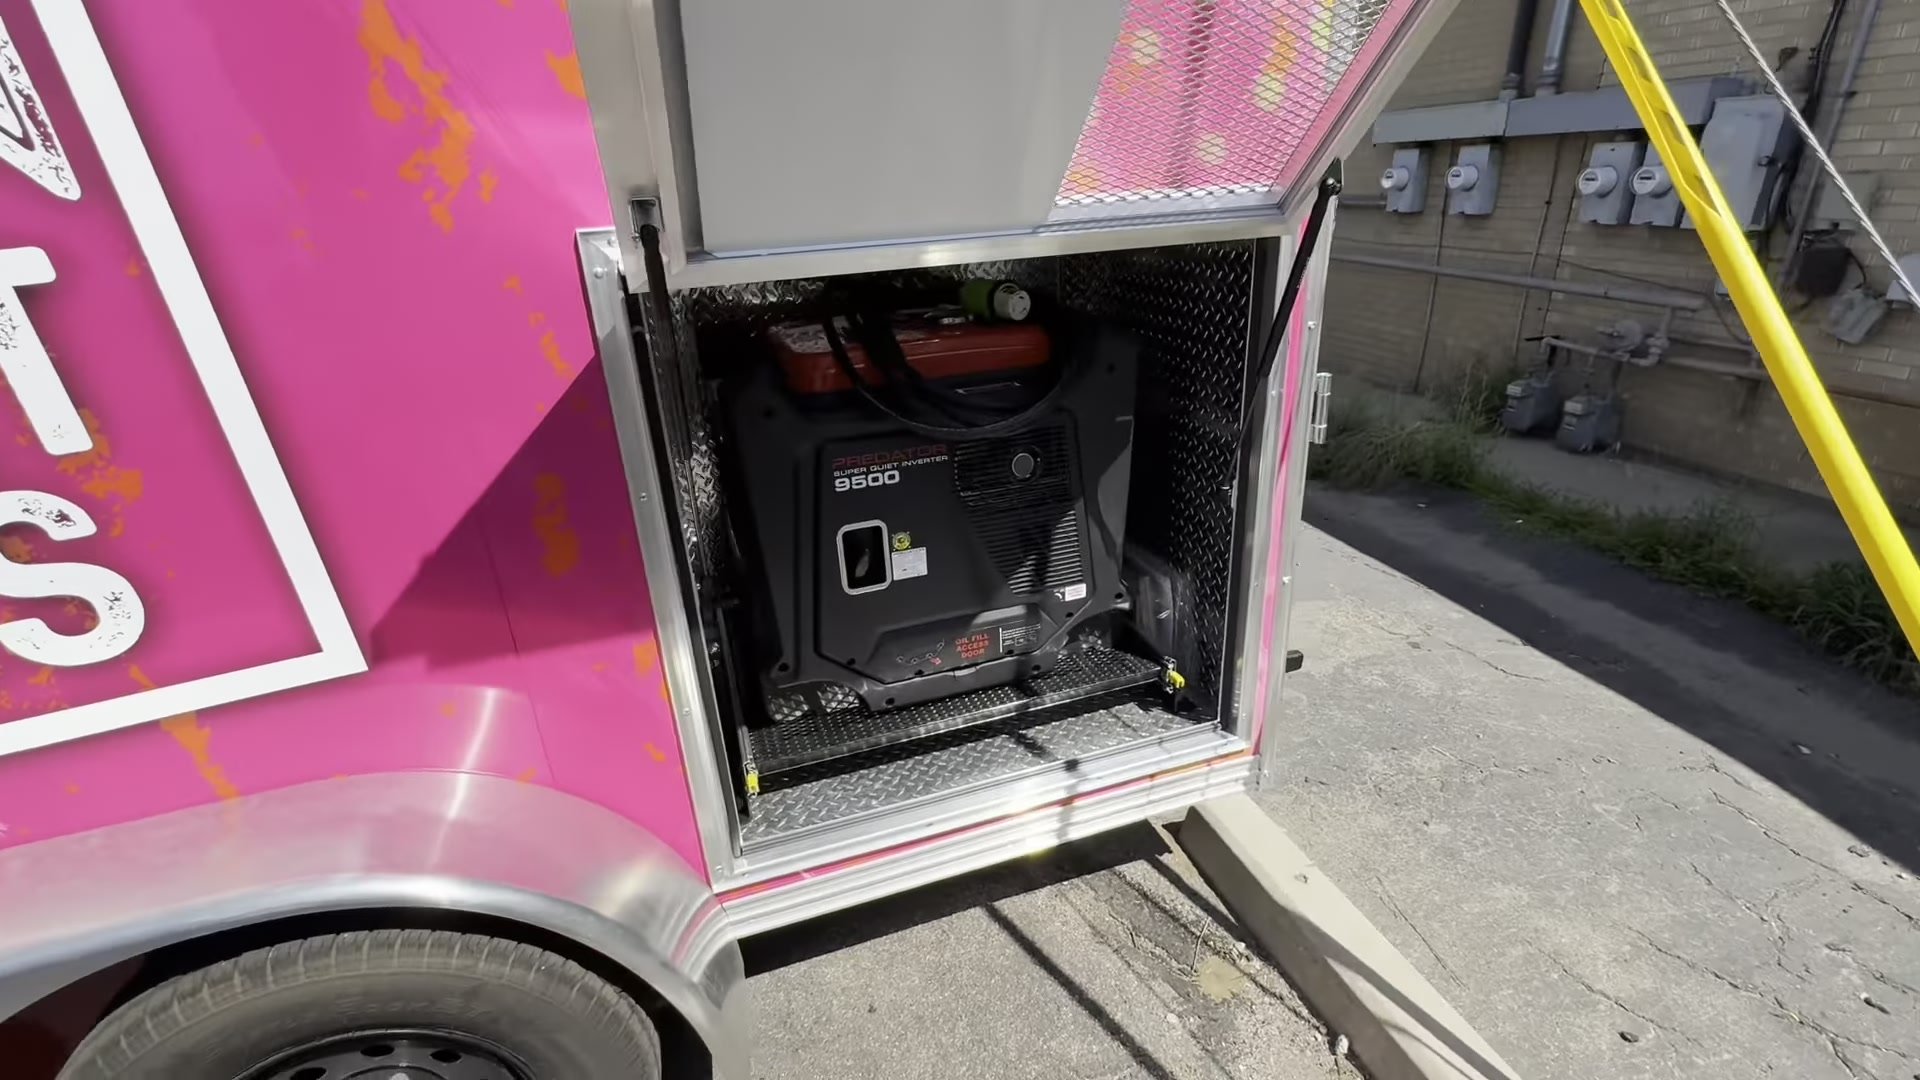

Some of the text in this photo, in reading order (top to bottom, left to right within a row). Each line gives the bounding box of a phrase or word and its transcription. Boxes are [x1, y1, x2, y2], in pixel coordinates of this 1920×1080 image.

[832, 444, 947, 469] PREDATOR
[833, 455, 948, 477] SUPER QUIET INVERTER
[834, 470, 900, 492] 9500
[955, 633, 989, 645] OIL FILL
[956, 640, 990, 652] ACCESS
[961, 648, 985, 659] DOOR
